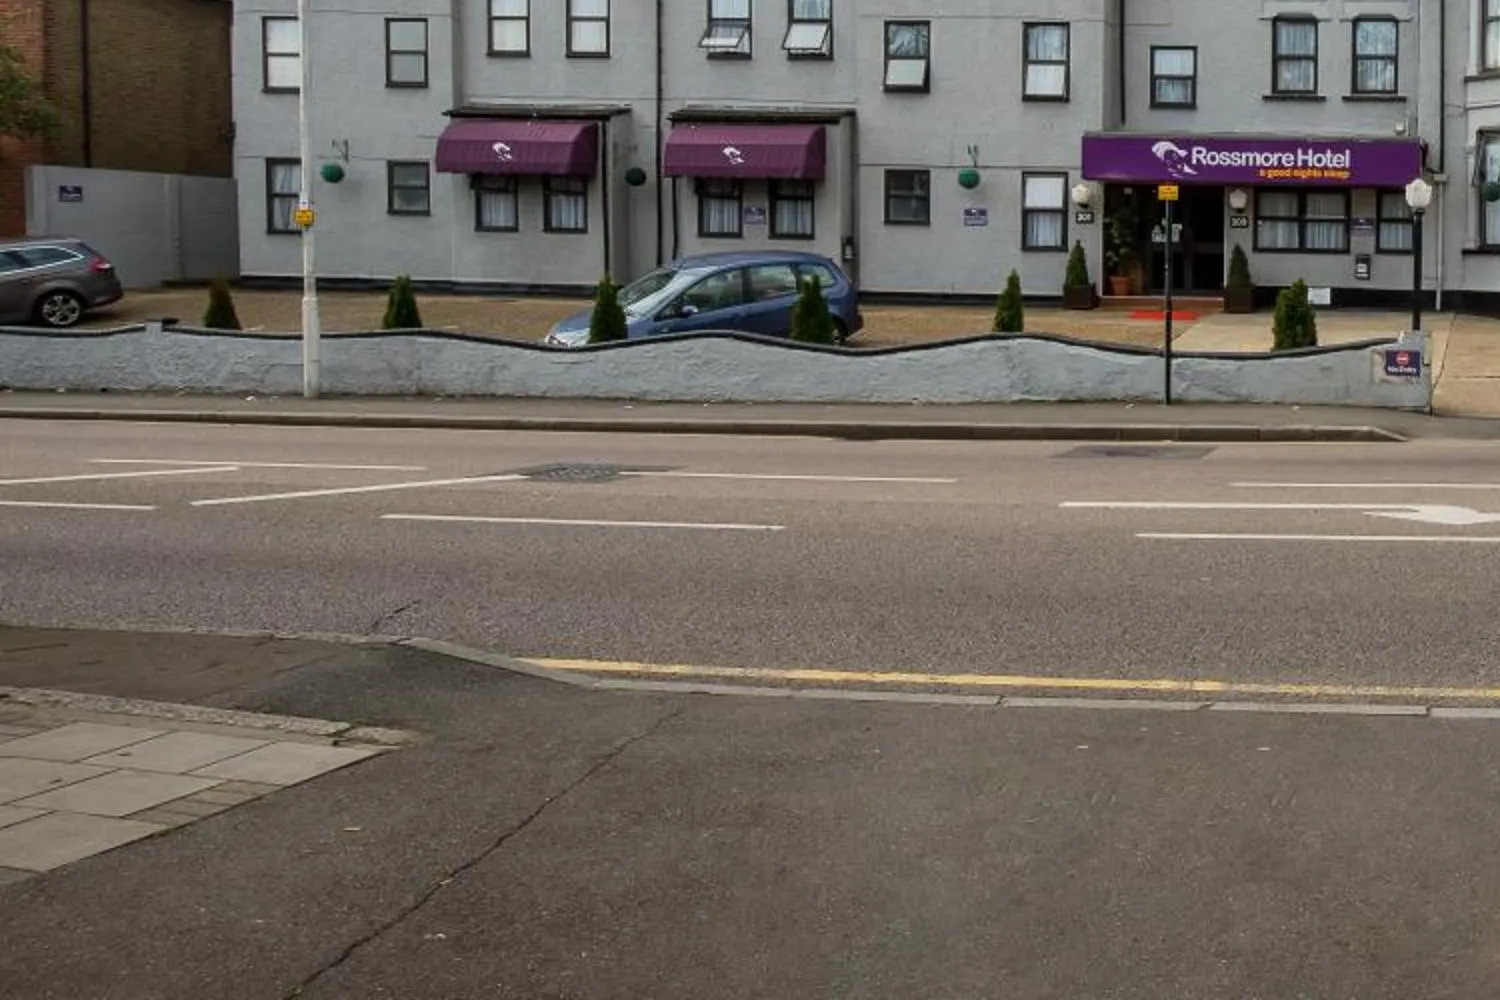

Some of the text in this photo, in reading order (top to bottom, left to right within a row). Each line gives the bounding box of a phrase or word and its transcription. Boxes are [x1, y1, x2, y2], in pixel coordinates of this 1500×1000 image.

[1191, 146, 1351, 168] Rossmore Hotel
[1267, 169, 1291, 179] good
[1293, 168, 1322, 179] nights
